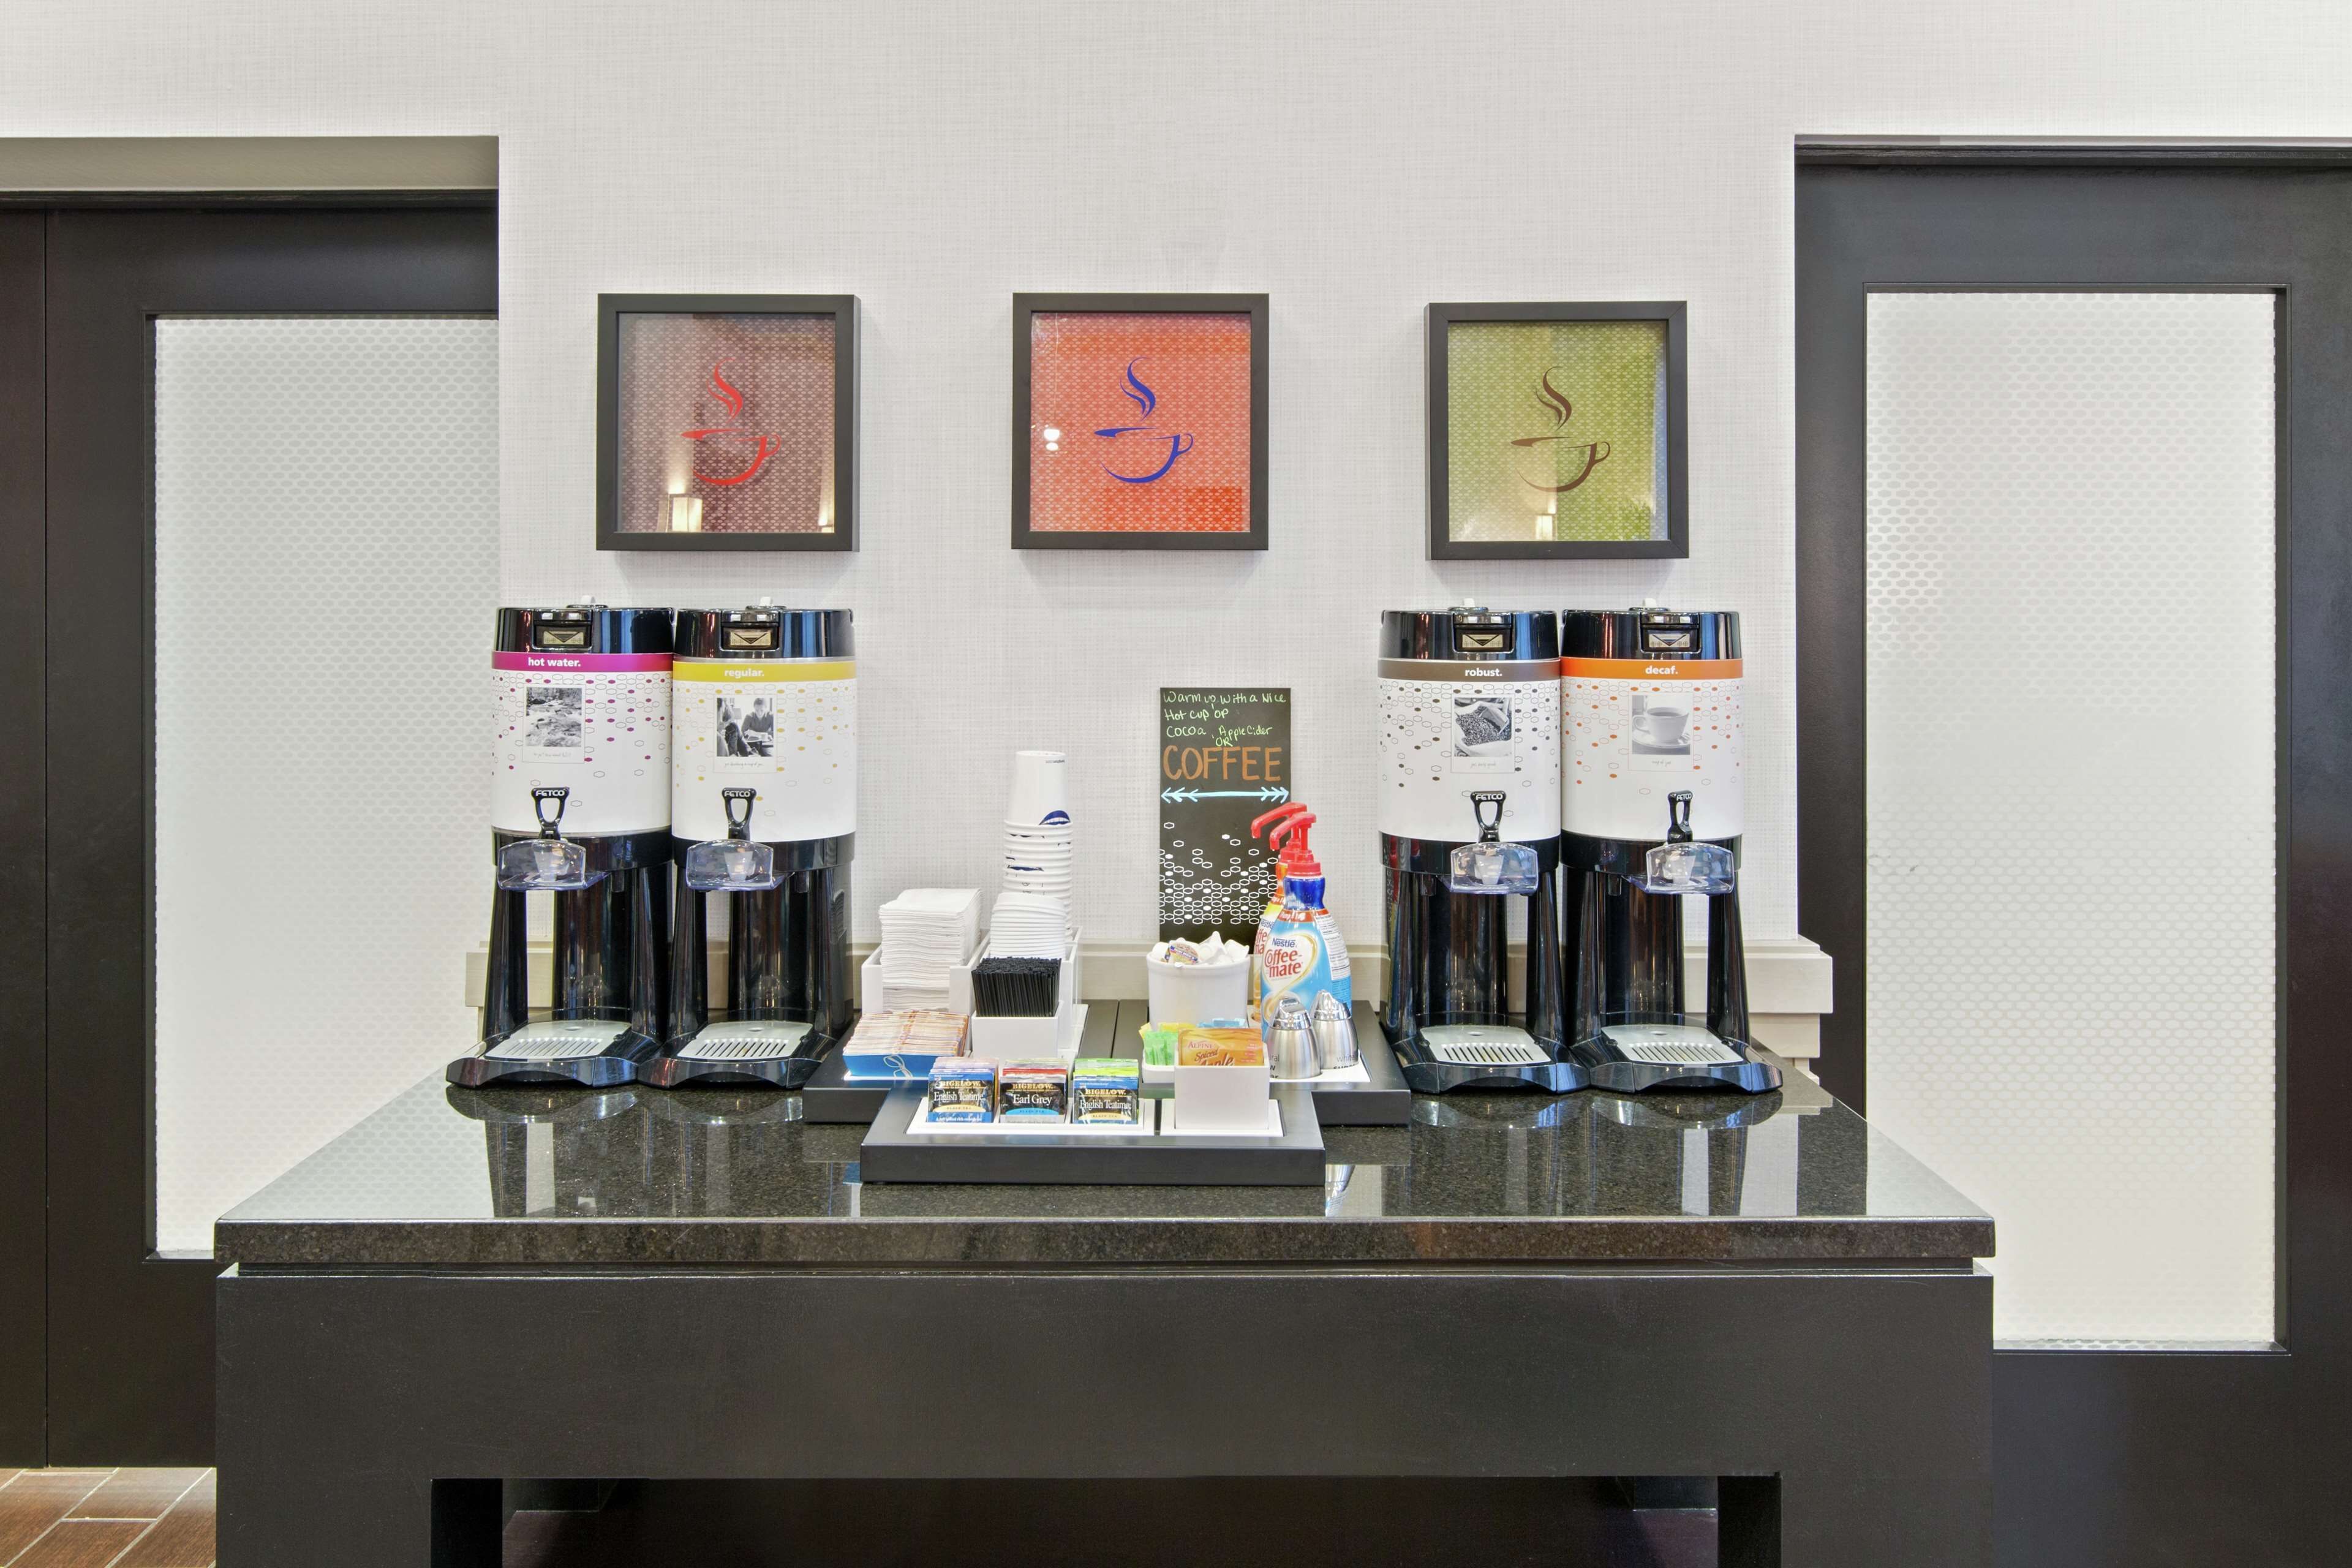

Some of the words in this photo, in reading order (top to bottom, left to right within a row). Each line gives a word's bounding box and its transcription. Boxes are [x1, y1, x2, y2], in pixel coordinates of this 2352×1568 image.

[528, 657, 545, 666] hot
[547, 658, 581, 667] water.
[725, 668, 765, 679] regular.
[1464, 668, 1502, 677] robust.
[1645, 665, 1678, 674] decaf.
[1163, 691, 1201, 703] Warm
[1262, 693, 1286, 704] Nice
[1164, 709, 1187, 721] Hot
[1218, 725, 1246, 742] Apple
[1163, 745, 1282, 782] COFFEE
[1269, 962, 1302, 978] mate
[1195, 1049, 1219, 1062] Spiced
[933, 1091, 957, 1103] English
[1013, 1094, 1030, 1104] Earl
[1031, 1095, 1052, 1106] Grey
[1080, 1099, 1103, 1110] English
